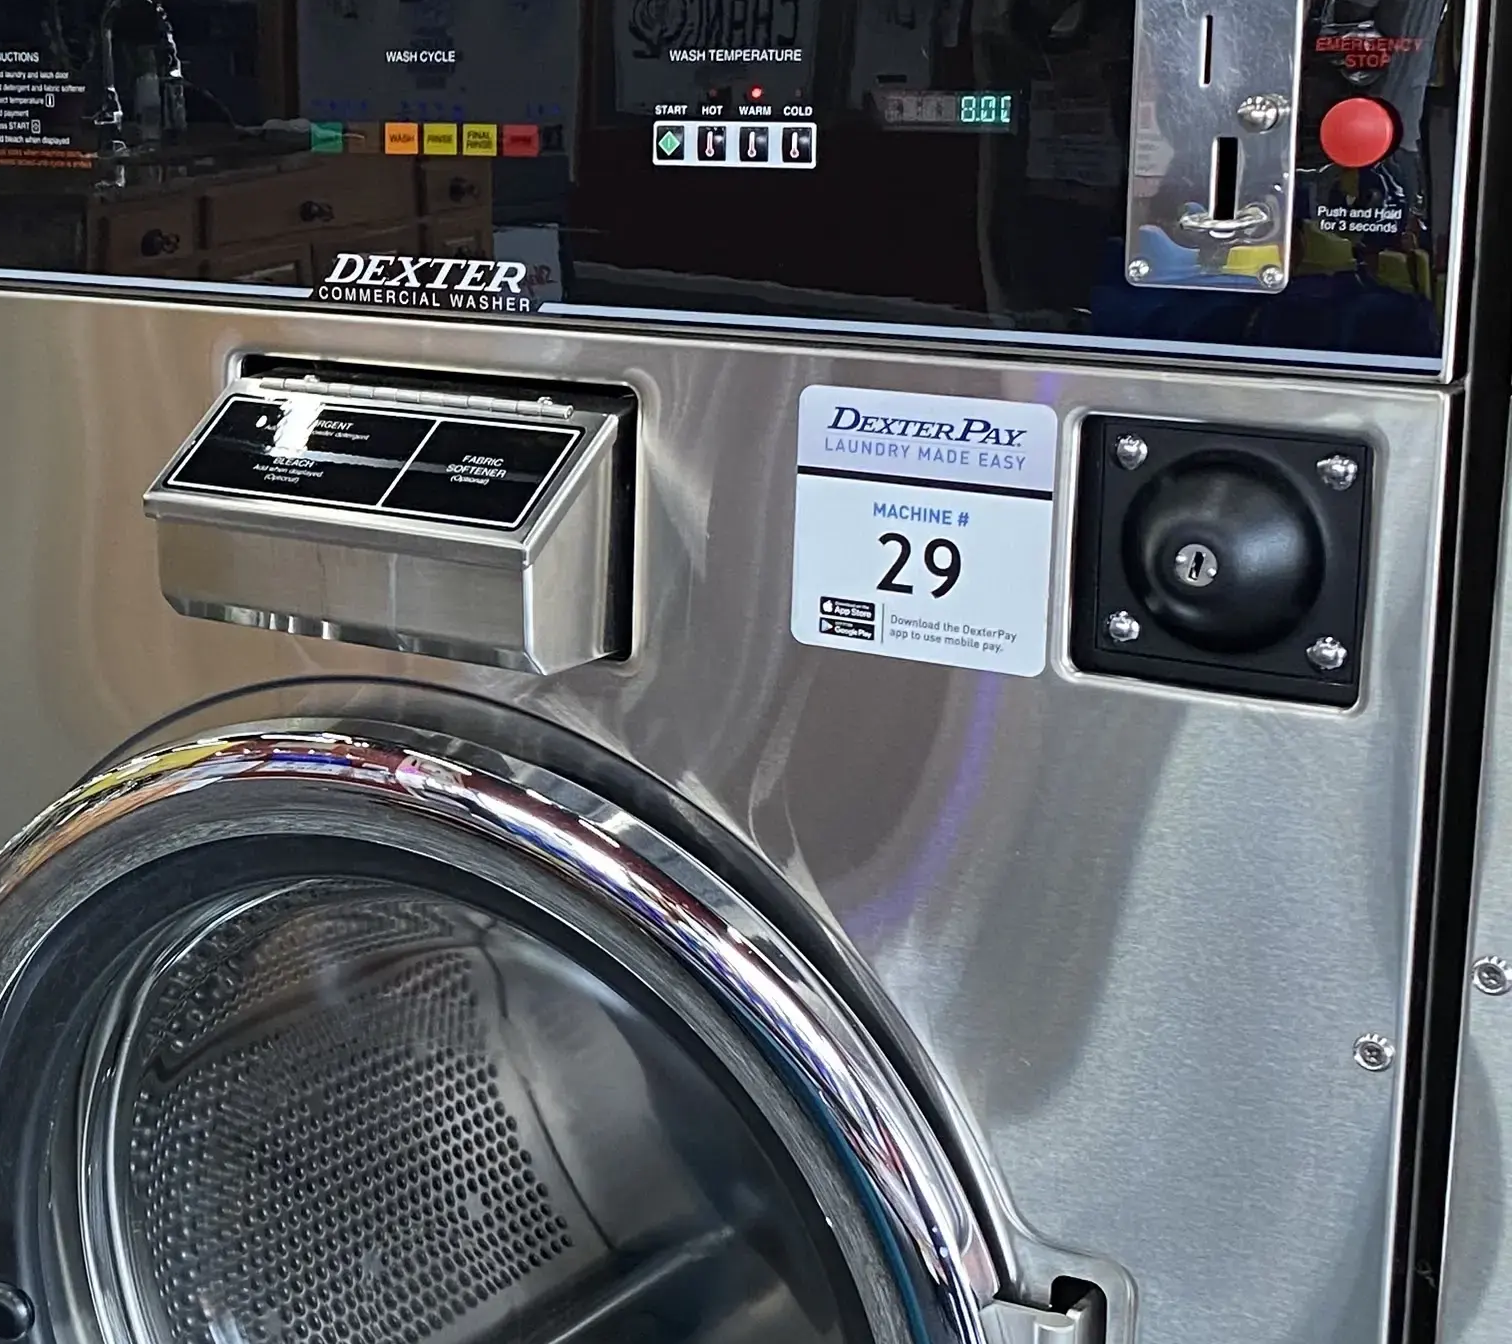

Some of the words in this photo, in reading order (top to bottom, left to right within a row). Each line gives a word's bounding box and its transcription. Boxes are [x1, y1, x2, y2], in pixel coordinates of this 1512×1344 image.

[1315, 38, 1425, 52] EMERGENCY
[386, 51, 417, 63] WASH
[419, 51, 456, 63] CYCLE
[669, 49, 705, 61] WASH
[709, 49, 802, 61] TEMPERATURE
[1345, 54, 1391, 67] STOP
[655, 105, 688, 115] START
[702, 105, 723, 115] HOT
[739, 106, 772, 116] WARM
[783, 106, 813, 116] COLD
[9, 121, 29, 129] START
[1317, 206, 1347, 217] Push
[1350, 208, 1372, 218] and
[1320, 219, 1336, 230] for
[1338, 220, 1347, 231] 3
[1349, 222, 1398, 233] seconds
[325, 254, 528, 294] DEXTER
[318, 285, 441, 307] COMMERCIAL
[450, 293, 531, 313] WASHER
[462, 455, 504, 467] FABRIC
[824, 437, 911, 459] LAUNDRY
[918, 447, 969, 465] MADE
[978, 453, 1026, 471] EASY
[273, 457, 315, 468] BLEACH
[446, 463, 507, 478] SOFTENER
[873, 502, 953, 525] MACHINE
[957, 511, 969, 527] #
[876, 532, 962, 599] 29
[834, 606, 850, 617] App
[851, 608, 872, 619] Store
[890, 615, 940, 631] Download
[943, 621, 960, 633] the
[963, 624, 1017, 643] DexterPay
[889, 629, 908, 640] app
[911, 630, 921, 640] to
[923, 633, 941, 643] use
[944, 634, 980, 649] mobile
